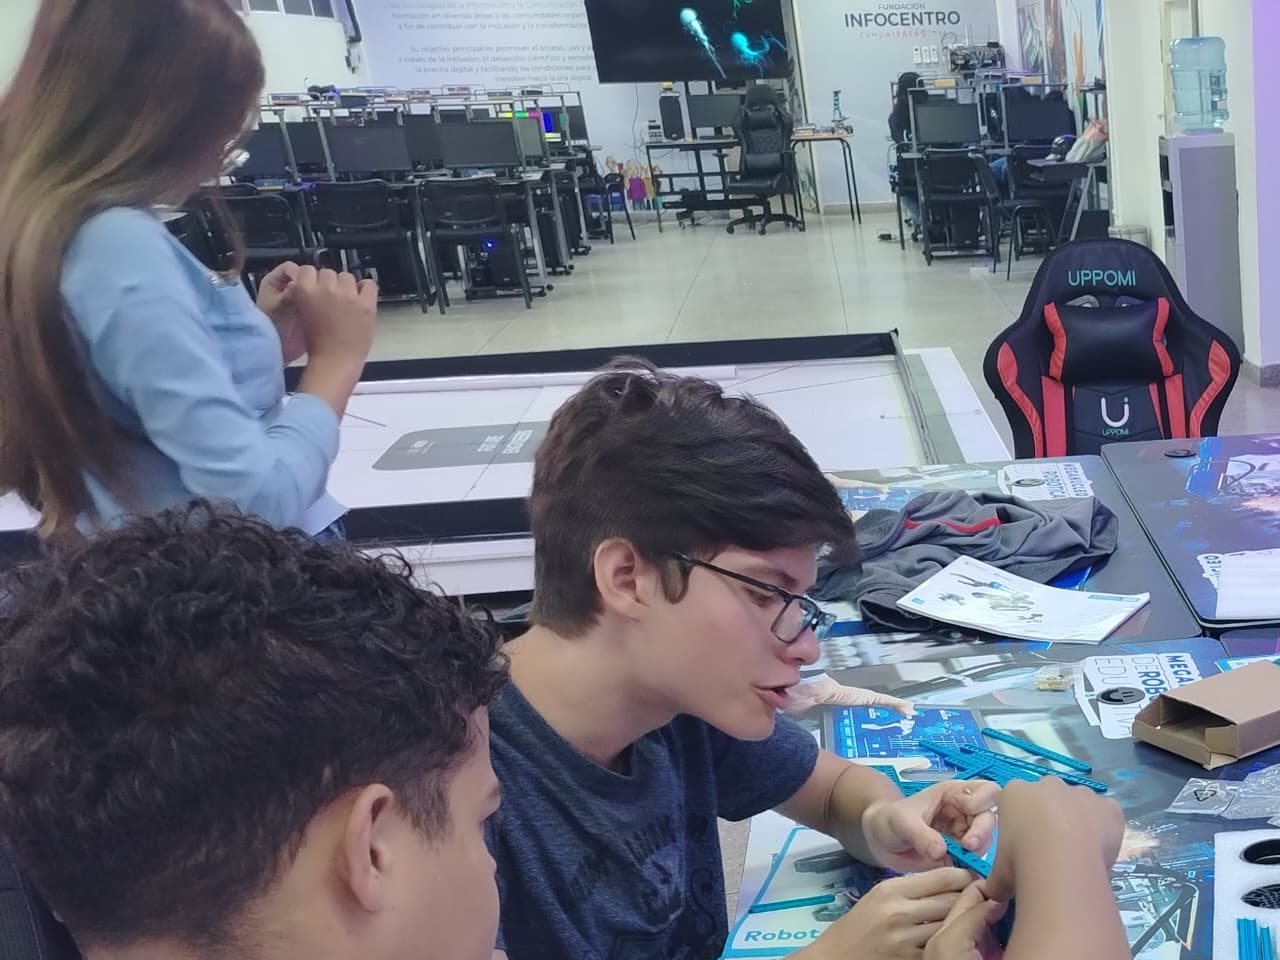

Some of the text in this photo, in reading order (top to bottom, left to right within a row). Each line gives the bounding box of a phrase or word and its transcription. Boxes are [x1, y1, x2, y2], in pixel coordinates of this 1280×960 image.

[844, 10, 961, 28] INFOCENTRO
[1067, 269, 1137, 287] UPPOMI
[1102, 427, 1130, 437] UPPOMI
[1164, 654, 1196, 687] MEGA
[743, 928, 822, 942] Robot
